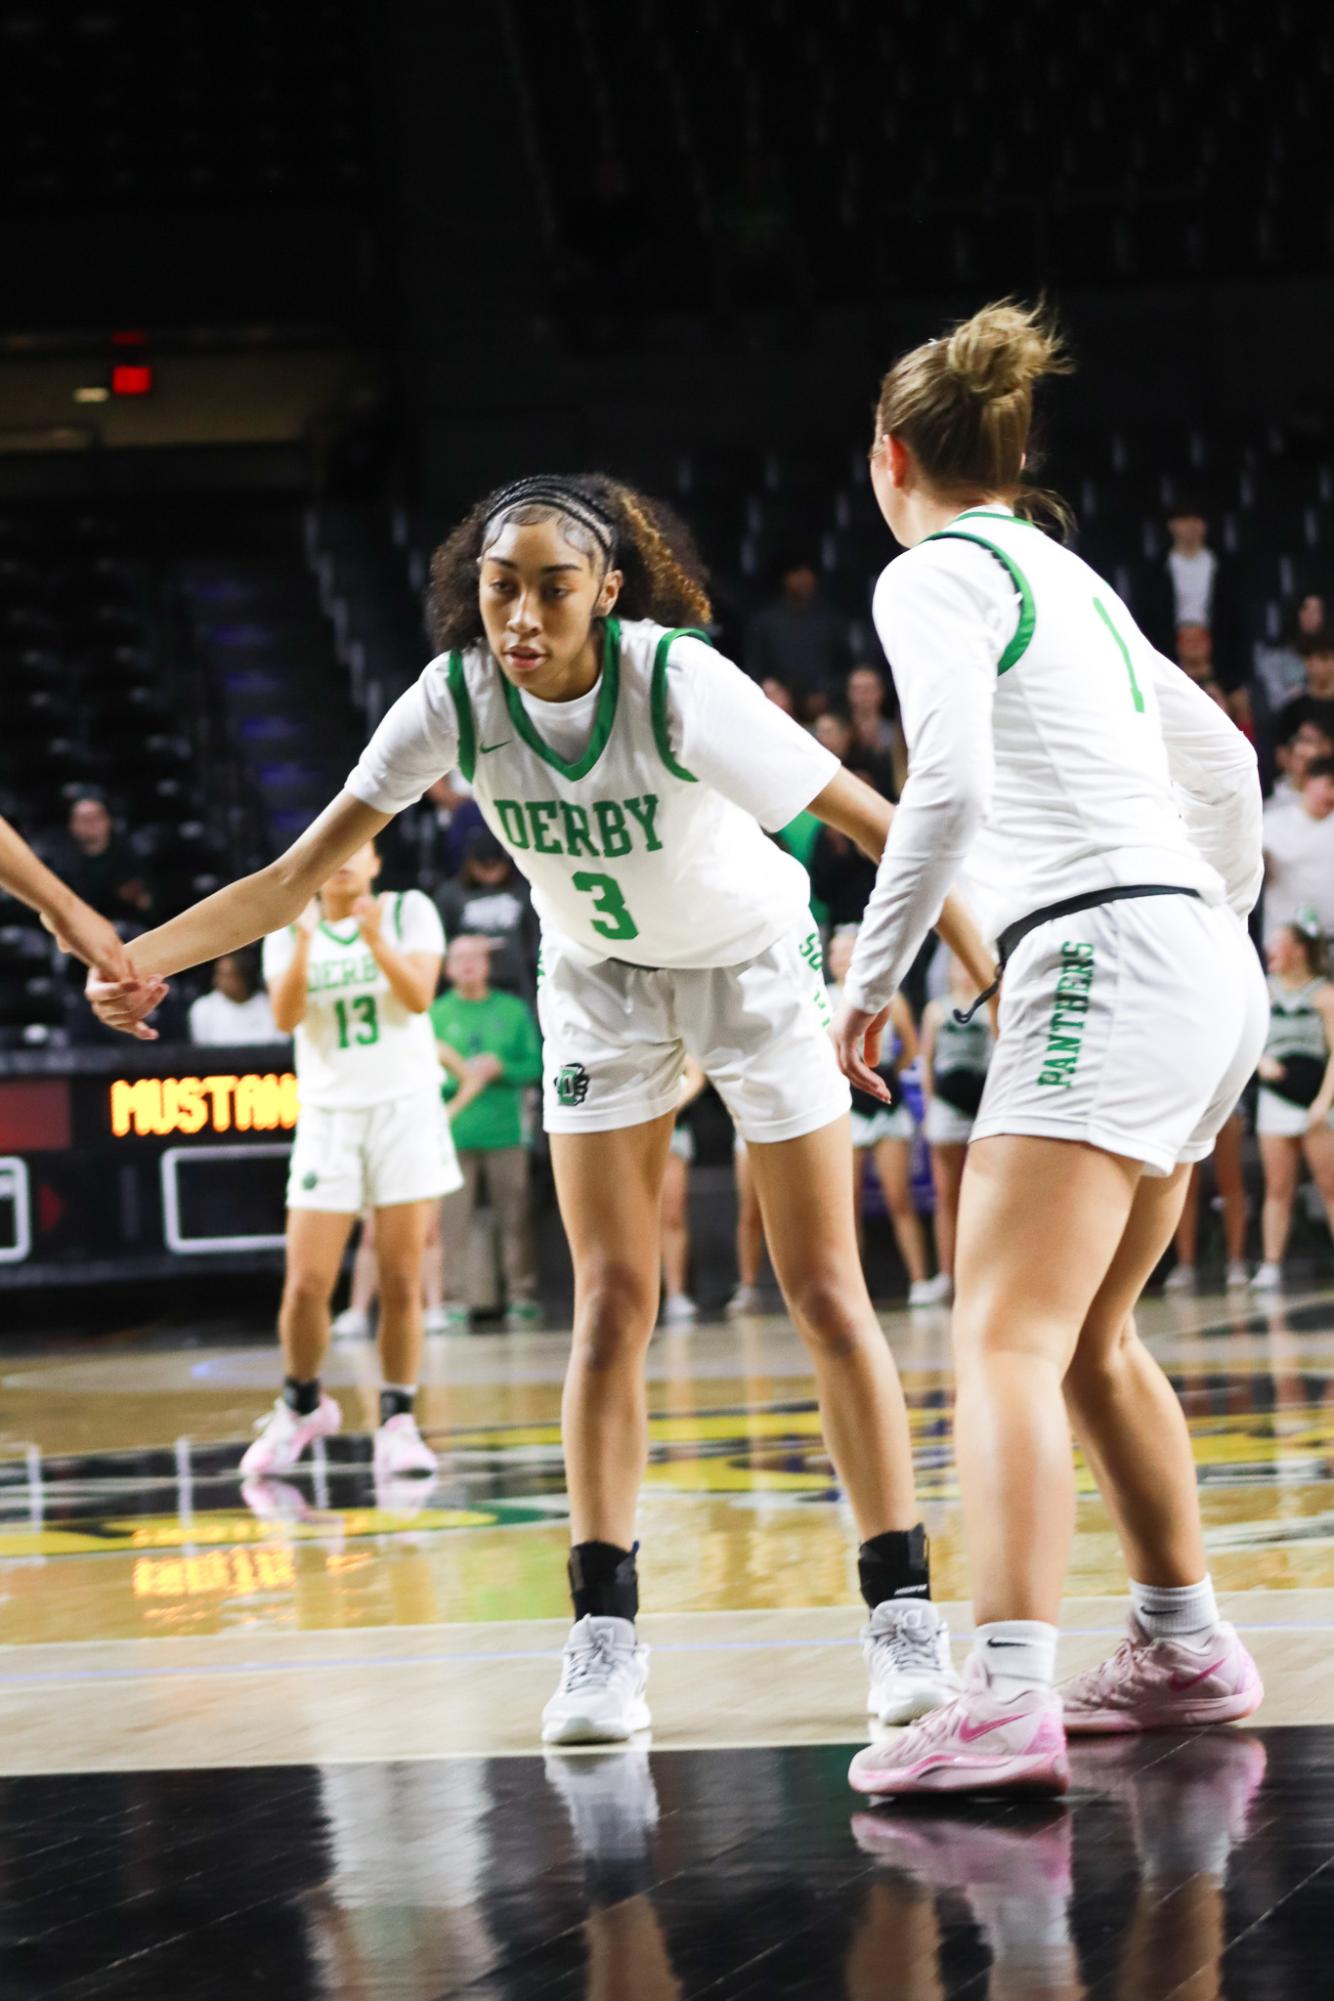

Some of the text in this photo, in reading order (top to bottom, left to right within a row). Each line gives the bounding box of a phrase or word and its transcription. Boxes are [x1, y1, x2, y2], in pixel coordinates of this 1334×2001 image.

[1092, 596, 1145, 713] 1
[493, 794, 663, 858] DERBY
[571, 870, 640, 940] 3
[307, 952, 380, 993] DERB
[333, 994, 380, 1049] 13
[1037, 940, 1095, 1088] PANTHERS
[110, 1072, 300, 1138] MUSTAN
